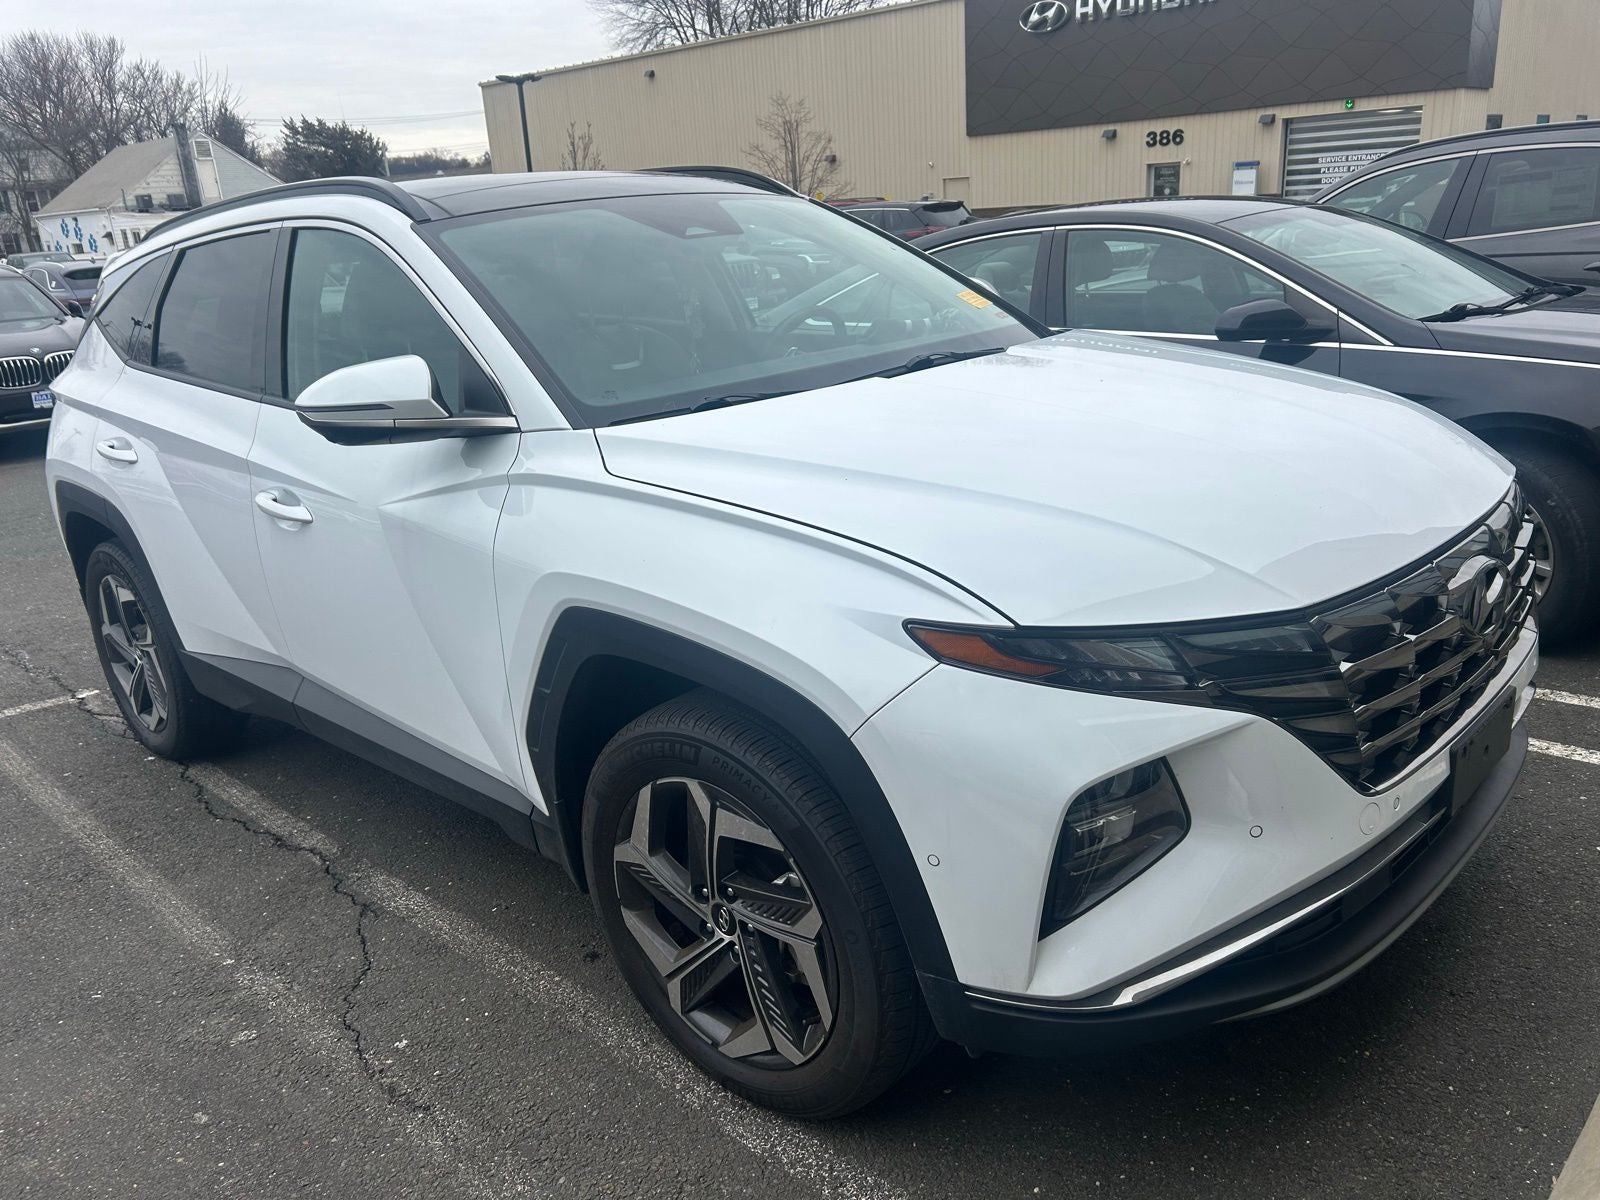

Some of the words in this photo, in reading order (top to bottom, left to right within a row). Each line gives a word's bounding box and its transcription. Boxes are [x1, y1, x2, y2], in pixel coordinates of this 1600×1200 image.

[1146, 129, 1185, 148] 386
[1318, 155, 1347, 164] SERVICE
[1320, 166, 1349, 174] PLEASE
[712, 757, 771, 801] PRIMACY
